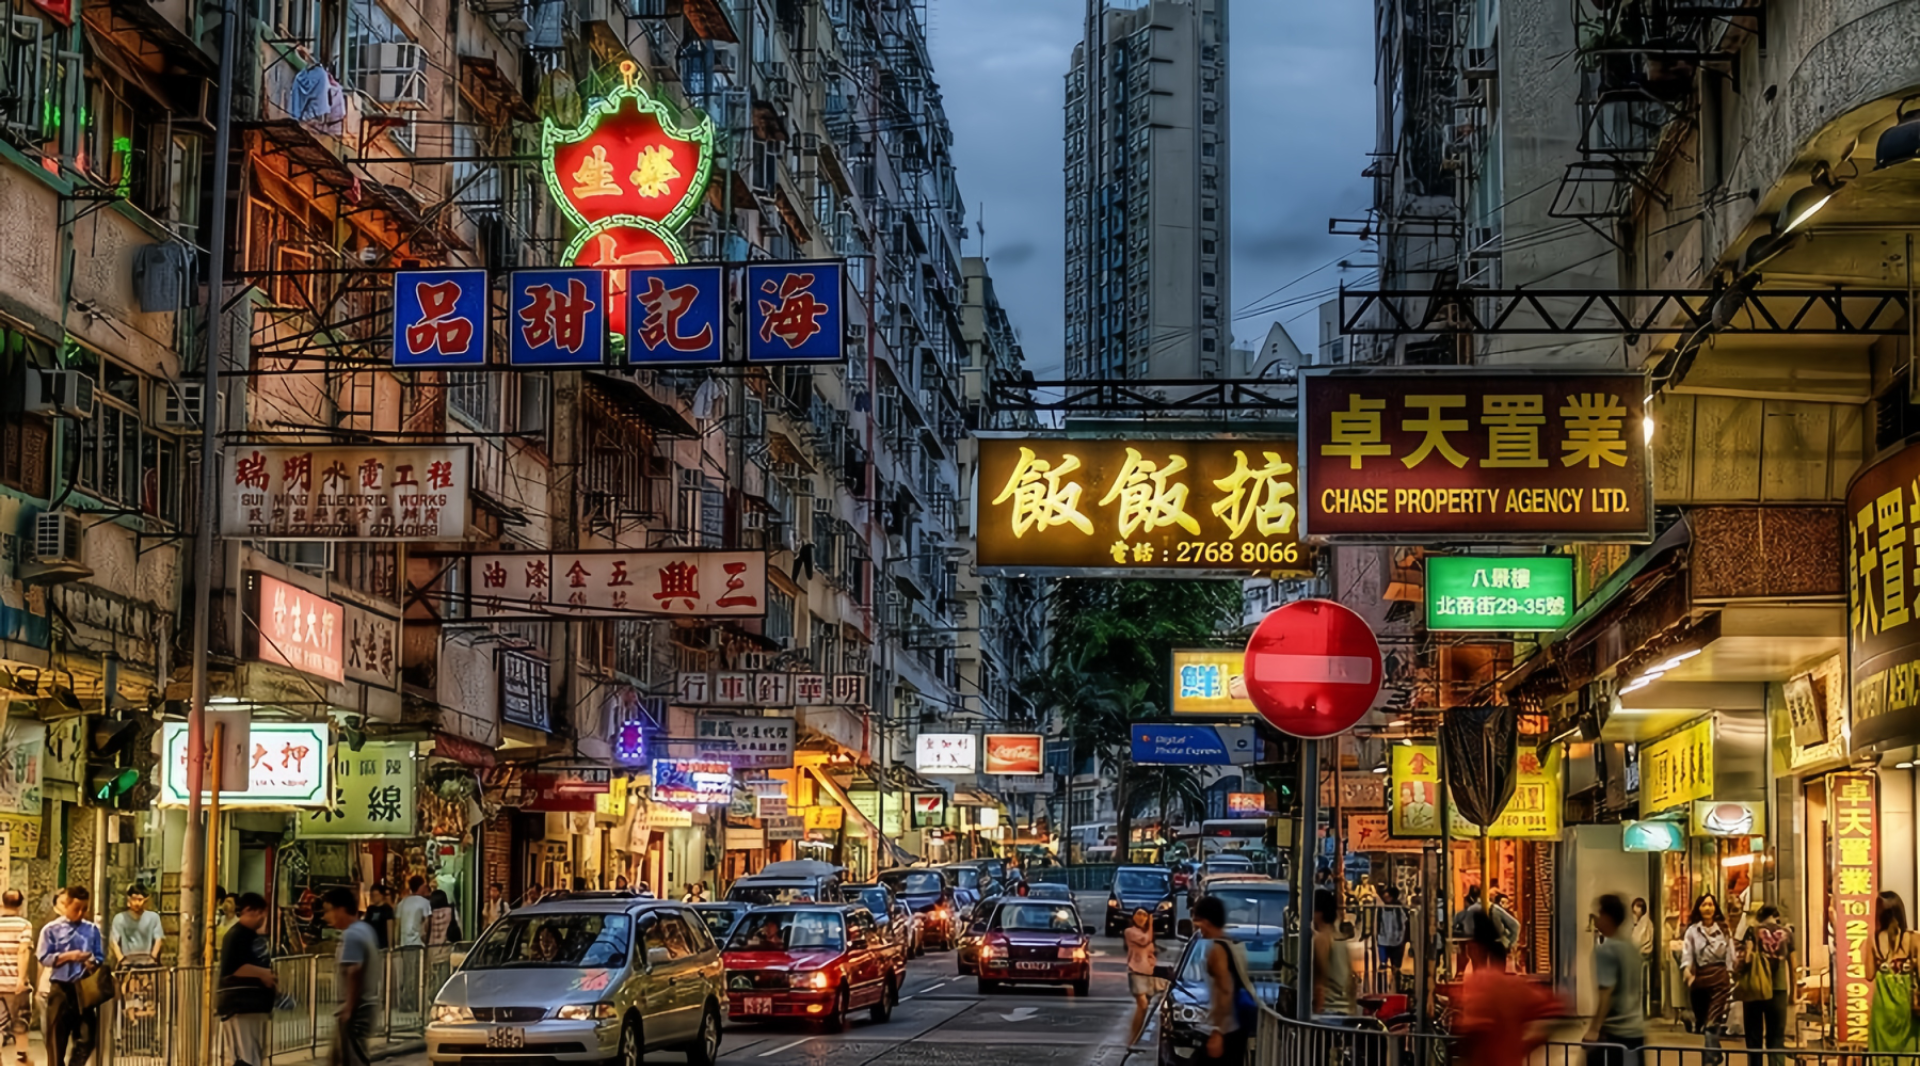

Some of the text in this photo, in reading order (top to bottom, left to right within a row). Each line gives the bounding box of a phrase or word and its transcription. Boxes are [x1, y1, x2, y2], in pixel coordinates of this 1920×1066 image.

[1320, 394, 1628, 471] 卓天置業
[235, 450, 454, 492] 瑞明水電工程
[241, 494, 264, 507] SUI
[317, 494, 389, 507] ELECTRIC
[399, 494, 447, 507] WORKS
[992, 446, 1298, 540] 飯飯掂
[1321, 488, 1630, 514] CHASE PROPERTY AGENCY LTD.
[1176, 541, 1234, 564] 2768
[1240, 541, 1299, 564] 8066
[1837, 778, 1873, 896] 卓天置業
[1840, 899, 1871, 916] Tel
